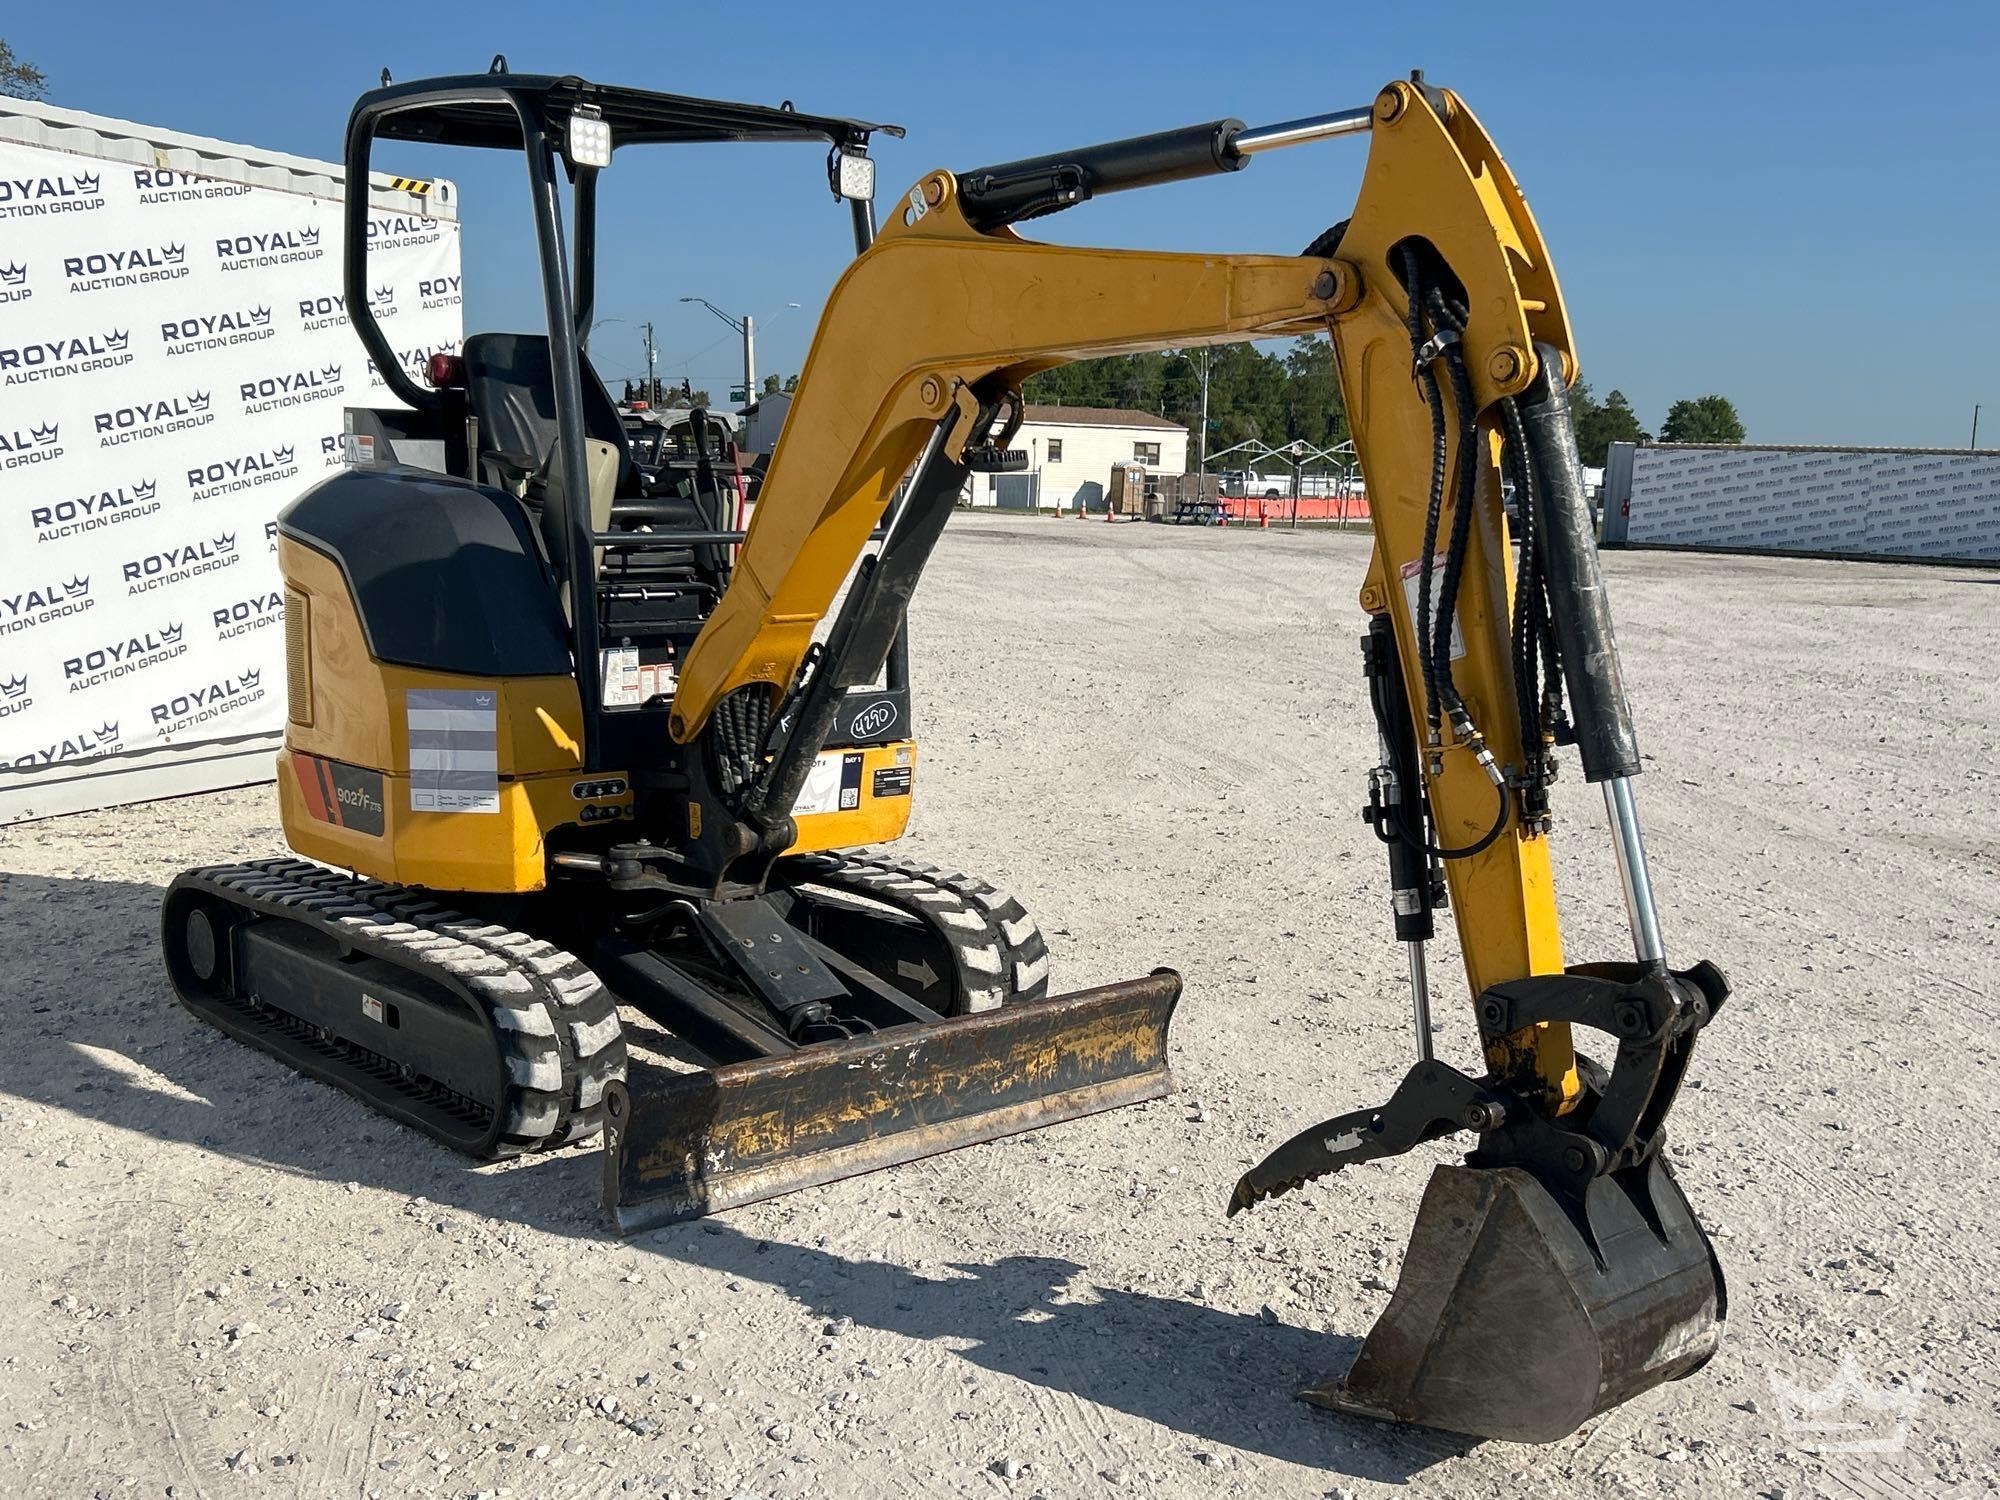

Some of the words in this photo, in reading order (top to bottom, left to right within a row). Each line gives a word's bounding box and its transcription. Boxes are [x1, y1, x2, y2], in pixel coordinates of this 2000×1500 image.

[0, 177, 75, 201] OYAL
[139, 190, 202, 204] AUCTION
[205, 186, 252, 198] GROUP
[0, 204, 47, 218] CTION
[50, 198, 105, 213] GROUP
[367, 217, 420, 238] OYAL
[216, 232, 300, 257] ROYAL
[367, 239, 400, 251] CTION
[403, 234, 440, 246] GROUP
[64, 248, 162, 277] ROYAL
[221, 256, 278, 271] AUCTION
[281, 250, 323, 263] GROUP
[70, 274, 137, 293] AUCTION
[140, 268, 189, 282] GROUP
[419, 276, 461, 297] ROY
[0, 289, 32, 303] OUP
[422, 296, 461, 310] AUCTIO
[162, 312, 250, 342] ROYAL
[0, 336, 105, 370] ROYAL
[167, 337, 226, 356] AUCTION
[230, 329, 274, 344] GROUP
[5, 363, 79, 386] AUCTION
[81, 354, 134, 372] GROUP
[240, 371, 322, 401] ROYAL
[246, 395, 300, 415] AUCTION
[304, 386, 344, 402] GROUP
[94, 398, 188, 433] ROYAL
[101, 425, 164, 448] AUCTION
[167, 414, 214, 432] GROUP
[6, 447, 64, 468] GROUP
[188, 453, 274, 488] ROYAL
[193, 479, 251, 502] AUCTION
[254, 467, 298, 485] GROUP
[32, 489, 134, 528] ROYAL
[38, 516, 107, 543] AUCTION
[111, 502, 160, 523] GROUP
[123, 542, 214, 582] ROYAL
[129, 569, 190, 596] AUCTION
[193, 554, 239, 575] GROUP
[39, 599, 94, 623] GROUP
[213, 592, 284, 627] ROYA
[219, 614, 275, 641] AUCTION
[64, 634, 160, 679] ROYAL
[70, 662, 135, 693] AUCTION
[139, 645, 187, 668] GROUP
[0, 699, 33, 717] OUP
[151, 680, 240, 724] ROYAL
[157, 707, 218, 737] AUCTION
[220, 690, 264, 713] GROUP
[855, 708, 889, 735] 4290
